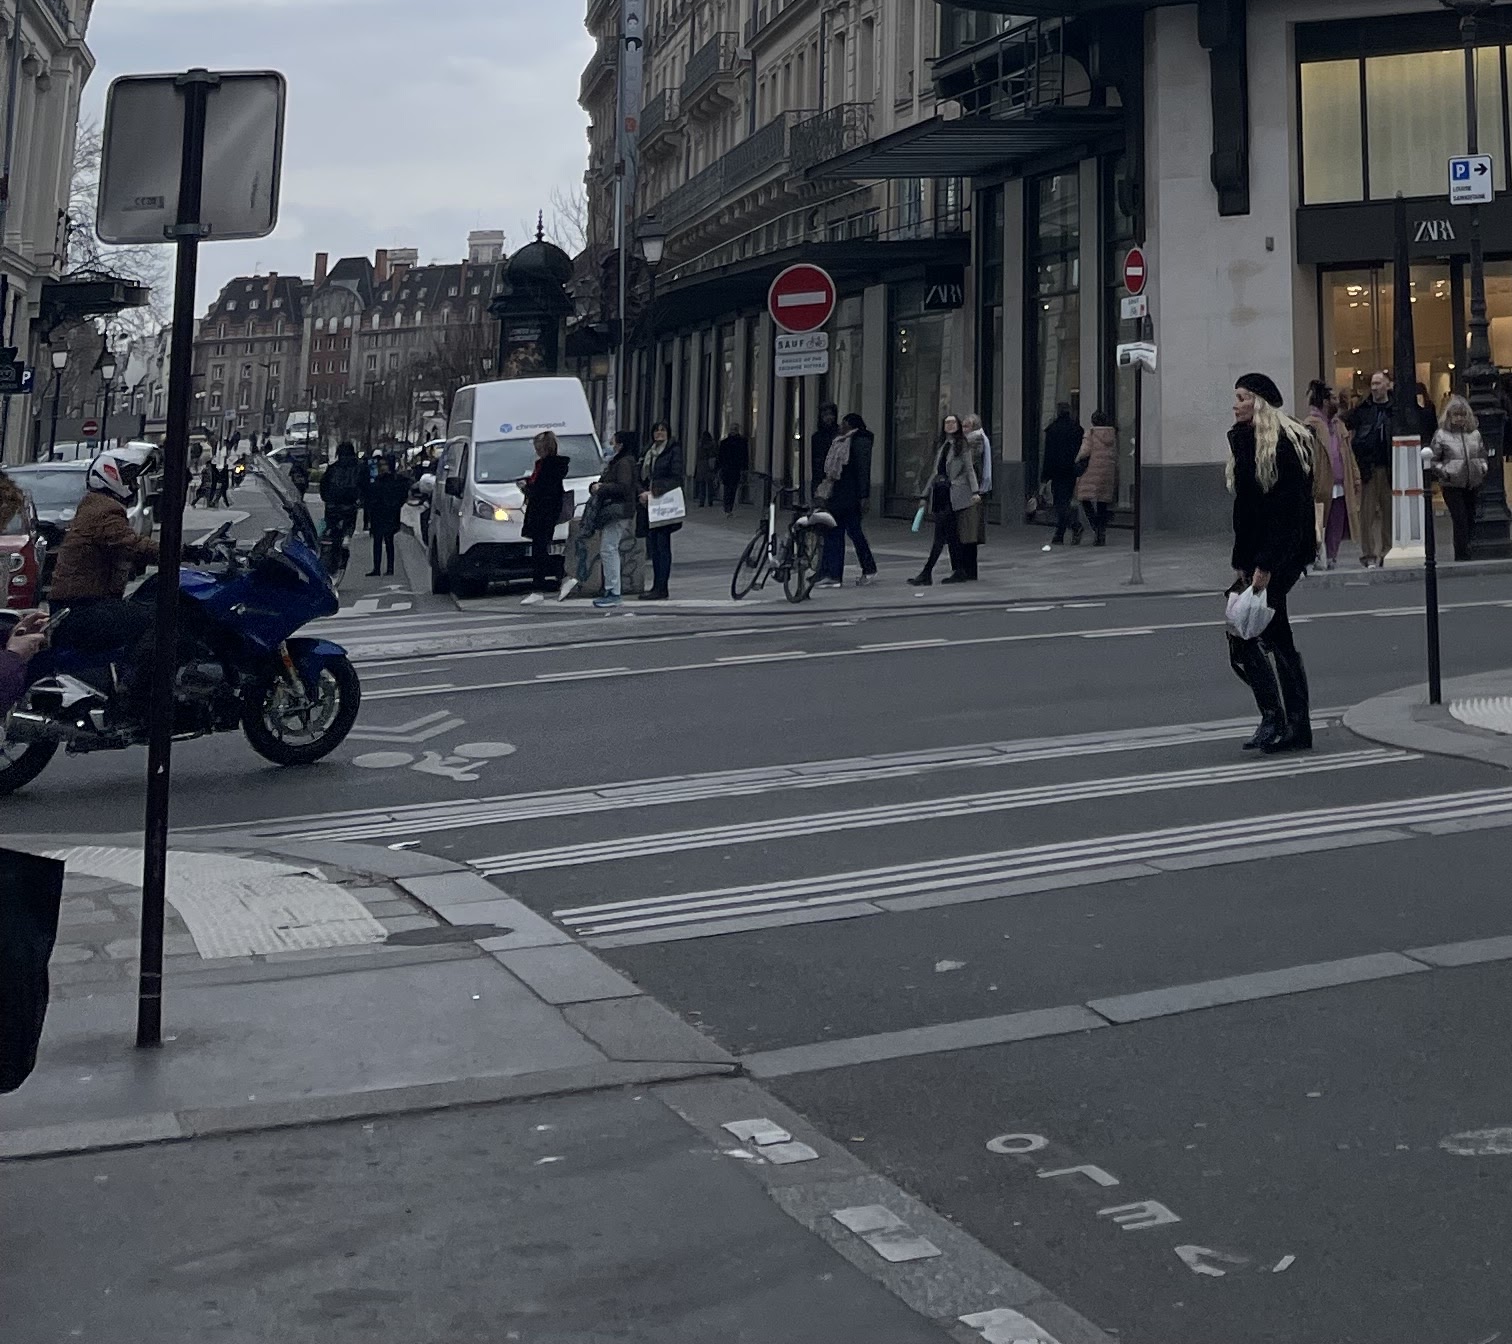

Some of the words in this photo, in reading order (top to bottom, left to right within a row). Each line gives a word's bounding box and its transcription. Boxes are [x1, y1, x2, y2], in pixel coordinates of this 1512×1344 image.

[1455, 164, 1466, 178] P
[1413, 218, 1456, 242] ZARA
[925, 284, 963, 304] ZARA
[778, 339, 804, 349] SAUF
[21, 370, 32, 385] P
[515, 421, 566, 431] chronopost
